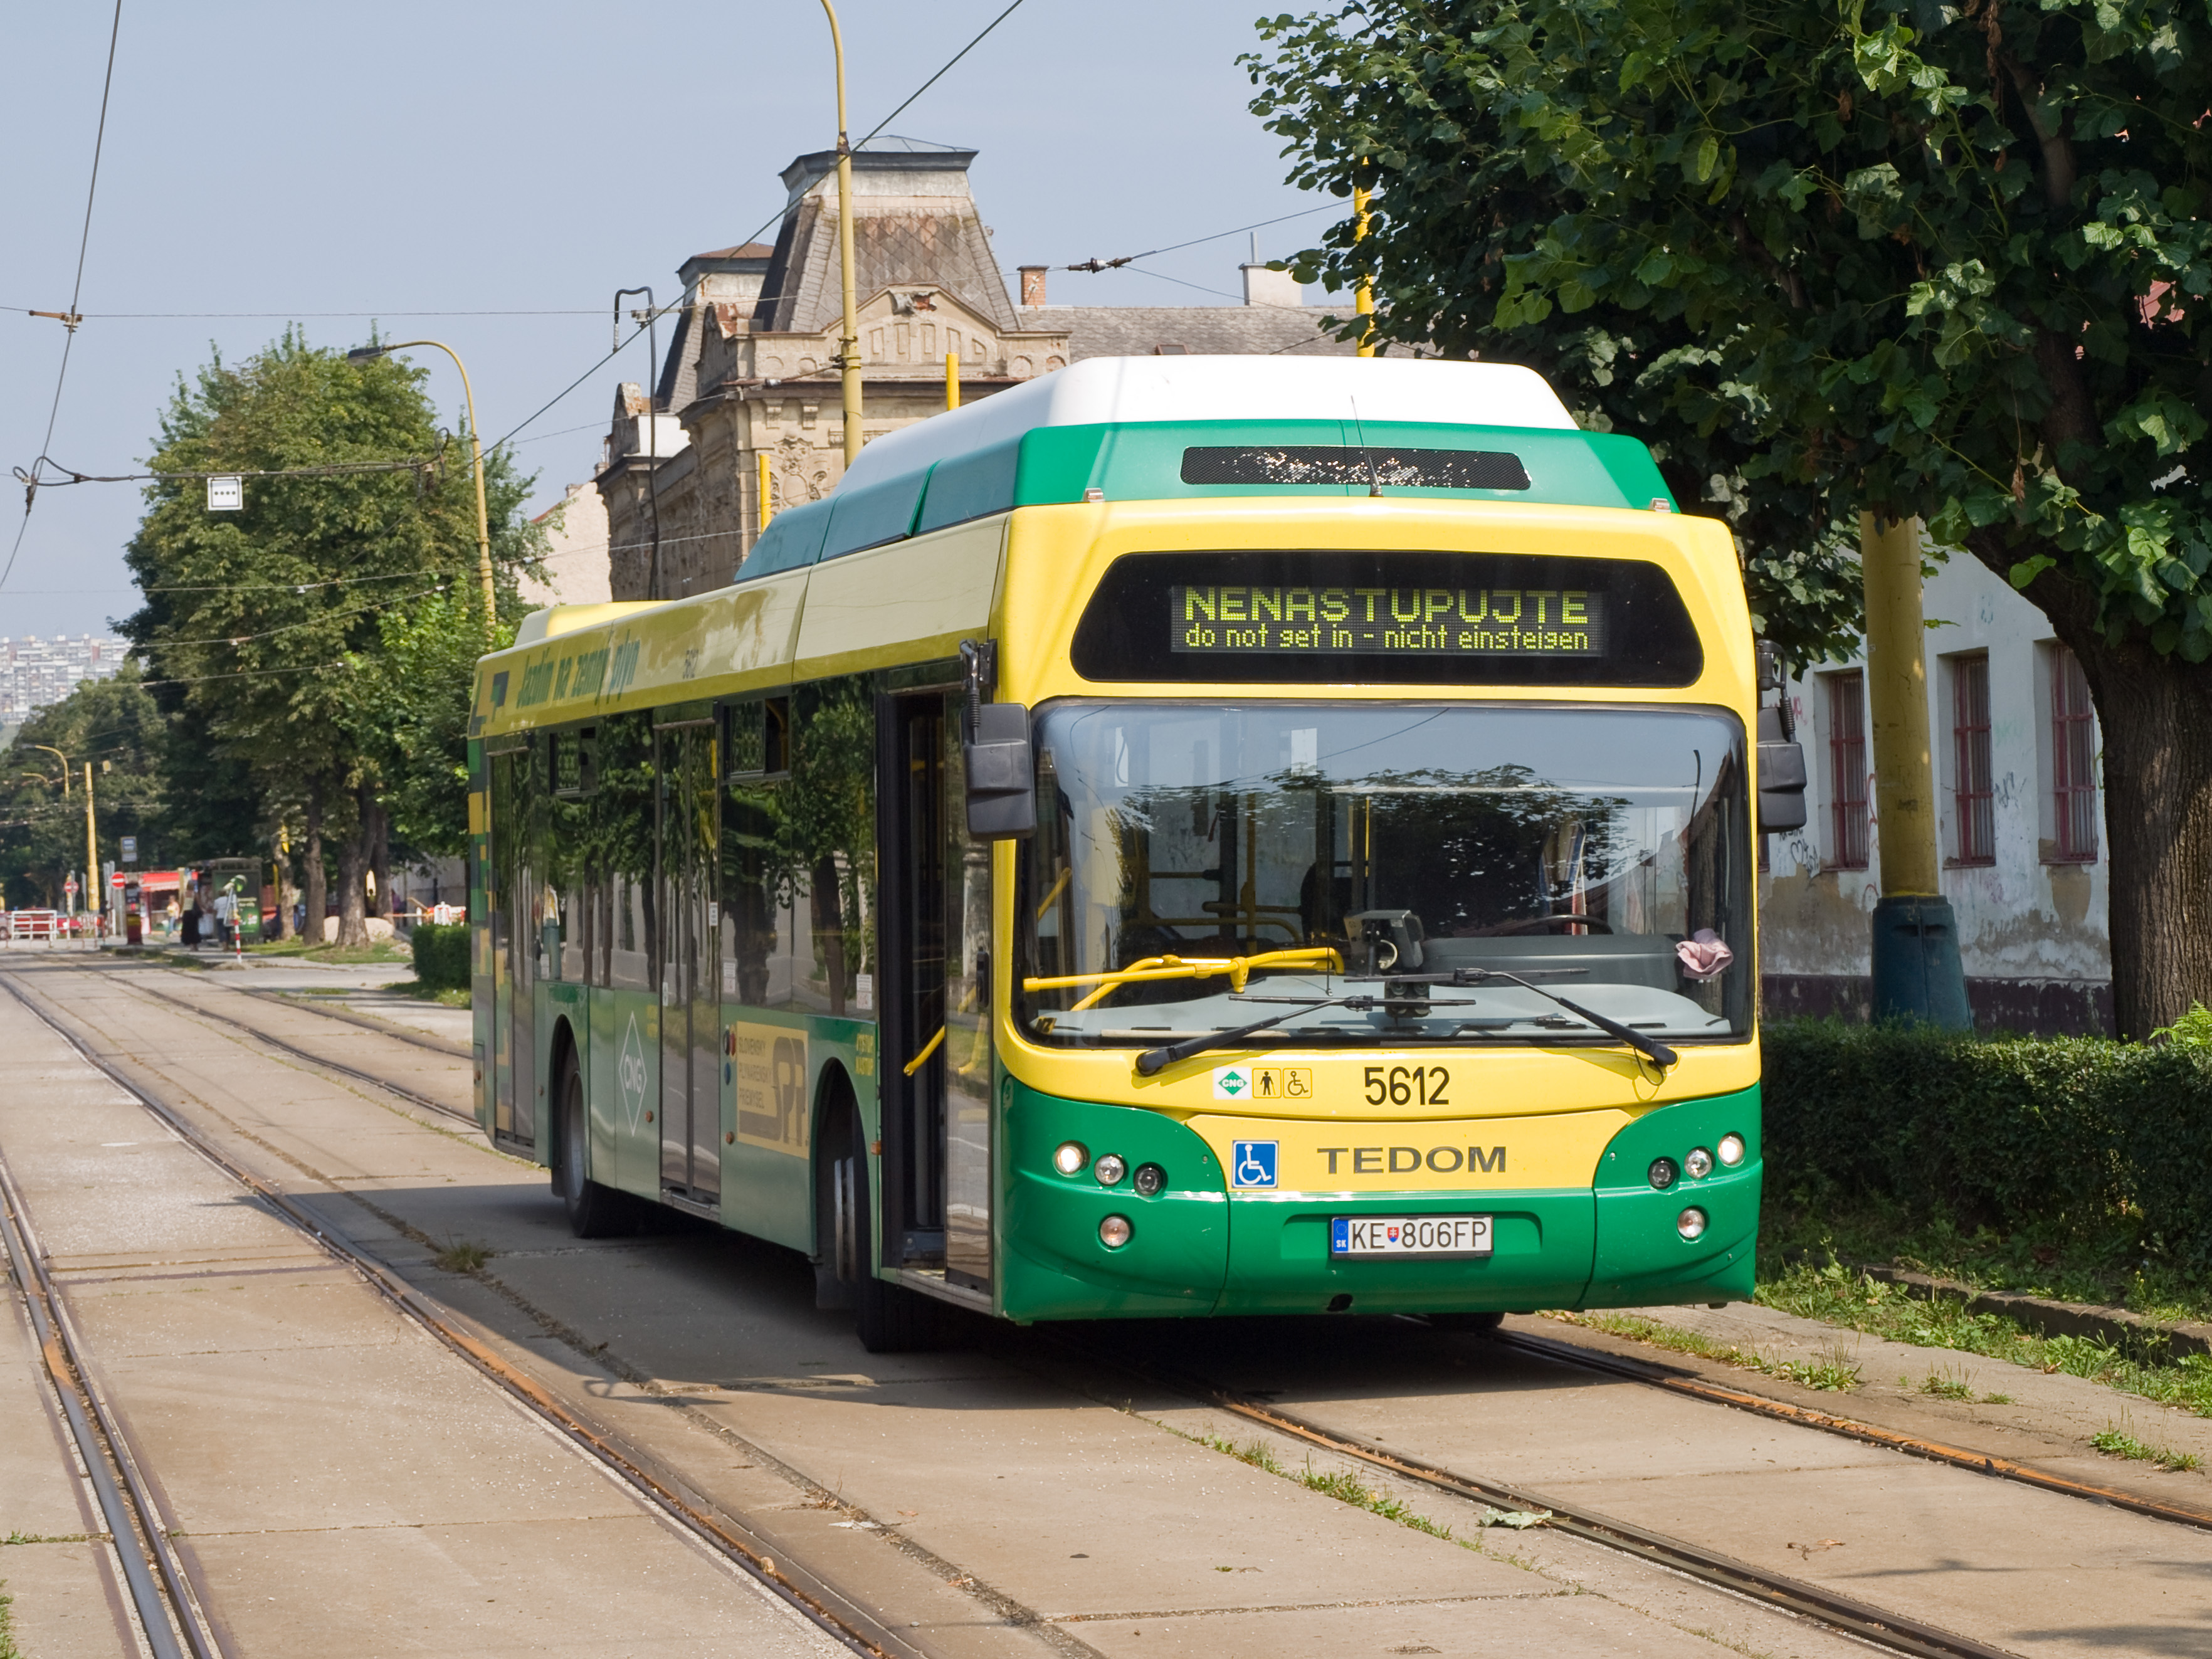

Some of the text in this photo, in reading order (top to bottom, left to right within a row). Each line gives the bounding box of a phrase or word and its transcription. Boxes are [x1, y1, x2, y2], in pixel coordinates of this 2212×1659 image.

[1186, 587, 1588, 624] NENASTUPUJTE
[1186, 623, 1216, 647] do
[1226, 623, 1268, 647] not
[1280, 623, 1321, 648] get
[1332, 623, 1352, 648] in
[1384, 624, 1448, 648] nicht
[1458, 624, 1588, 650] einsteigen
[624, 1054, 642, 1093] CNG
[1222, 1078, 1245, 1088] CNG
[1364, 1066, 1450, 1105] 5612
[1317, 1146, 1507, 1174] TEDOM
[1336, 1239, 1347, 1248] SK
[1352, 1221, 1487, 1249] KE 806FP
